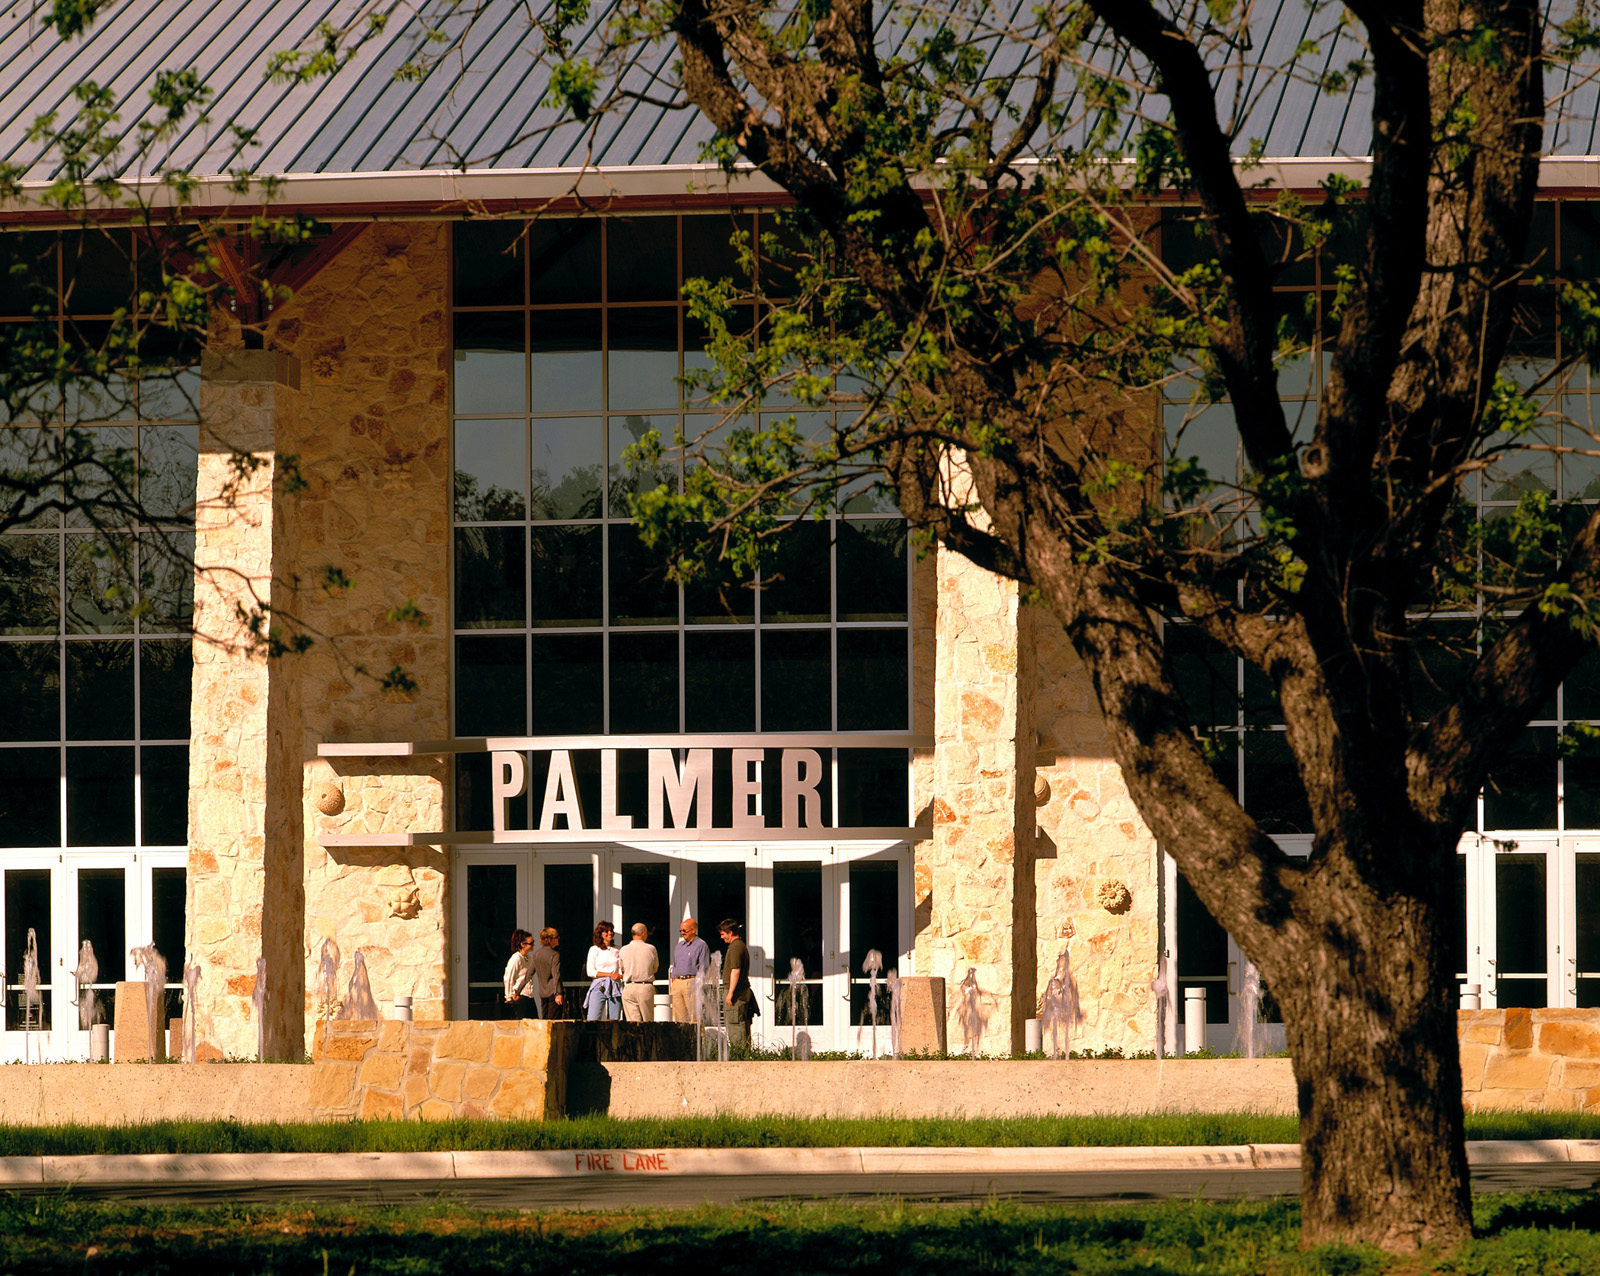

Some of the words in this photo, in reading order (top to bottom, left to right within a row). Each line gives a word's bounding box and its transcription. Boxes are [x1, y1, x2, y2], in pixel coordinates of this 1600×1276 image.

[491, 748, 824, 831] PALMER
[575, 1153, 614, 1171] FIRE
[623, 1153, 669, 1170] LANE
